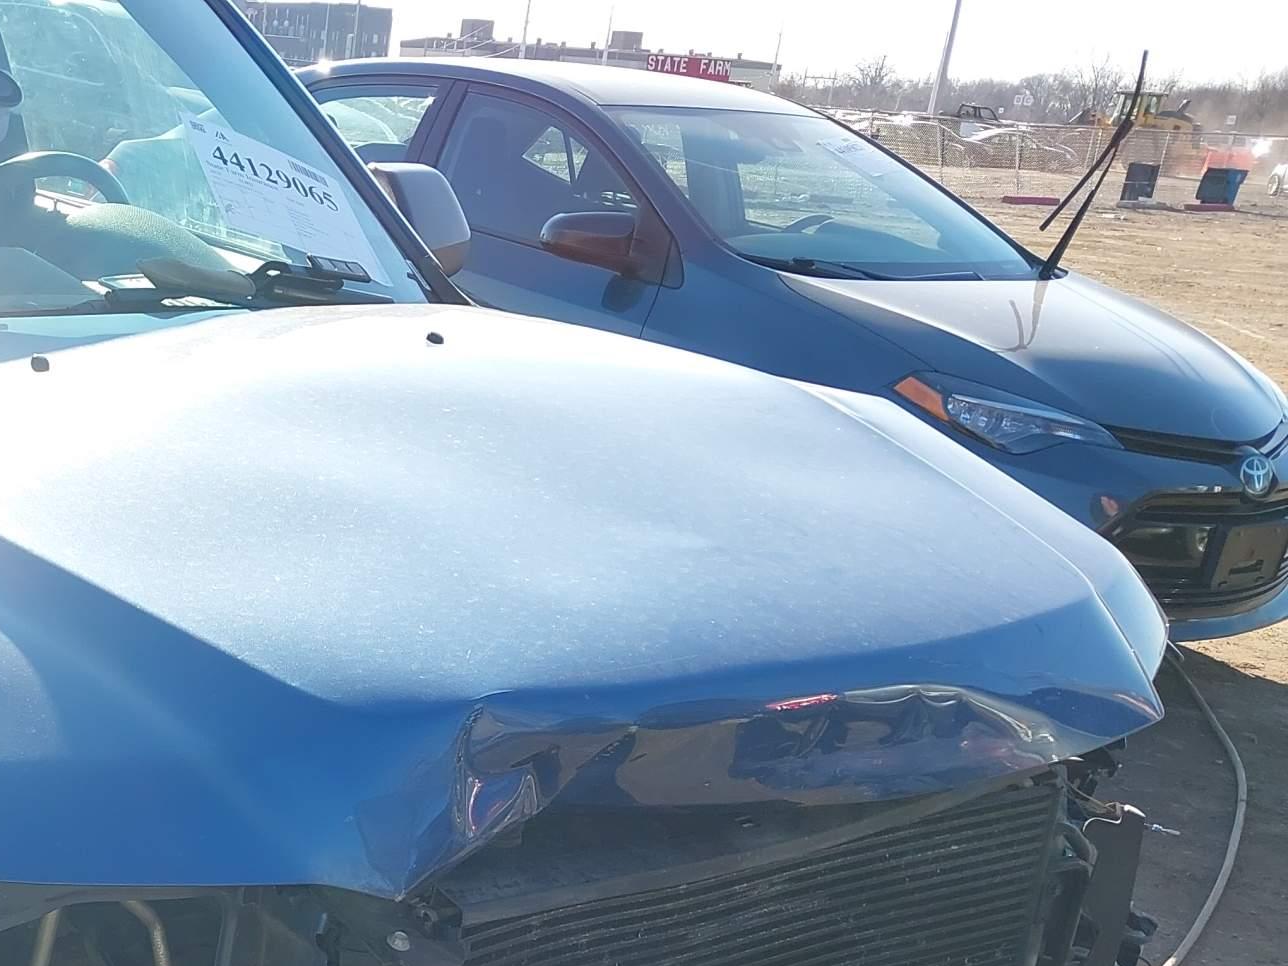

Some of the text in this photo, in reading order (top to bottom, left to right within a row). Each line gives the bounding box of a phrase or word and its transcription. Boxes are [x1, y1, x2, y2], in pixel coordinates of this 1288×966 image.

[648, 55, 732, 76] STATE FARM
[212, 145, 339, 212] 44129065
